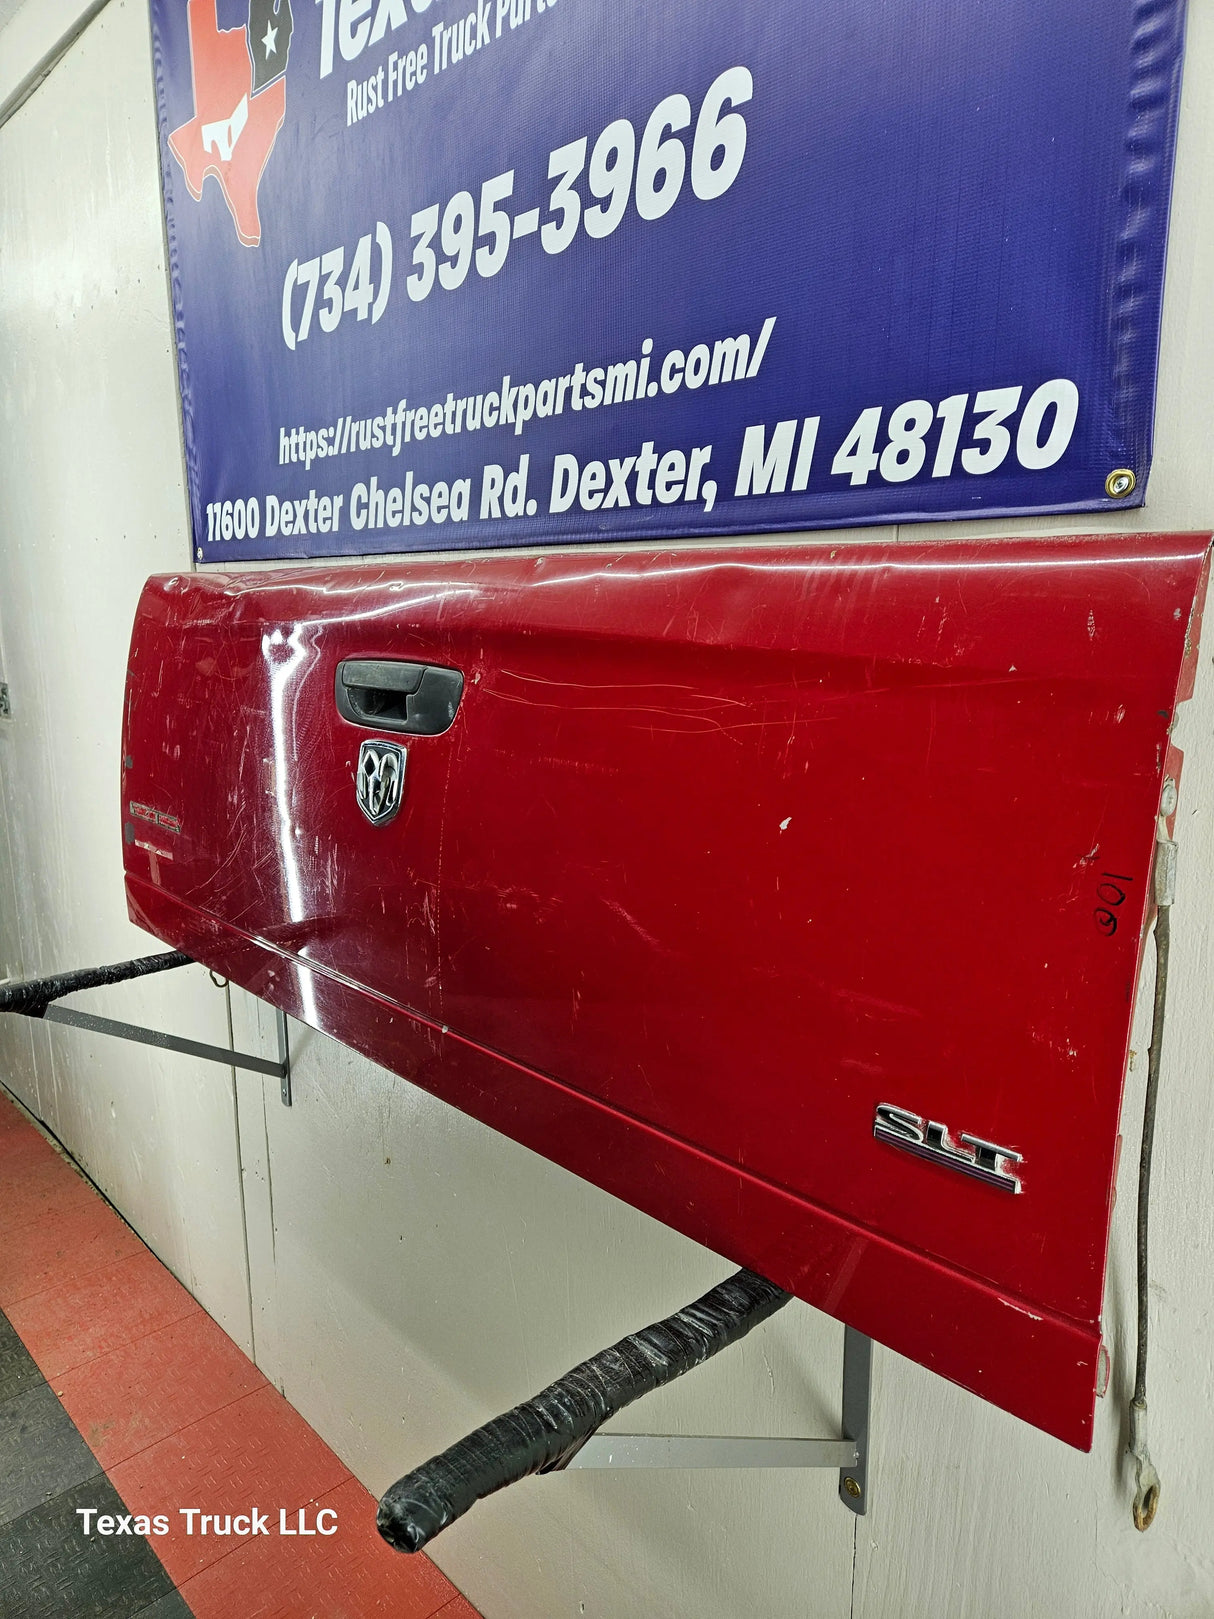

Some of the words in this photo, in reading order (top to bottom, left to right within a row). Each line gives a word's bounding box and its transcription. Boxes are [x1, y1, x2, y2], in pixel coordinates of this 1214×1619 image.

[315, 0, 439, 80] Tex
[347, 66, 385, 127] Rust
[388, 43, 428, 102] Free
[432, 0, 492, 75] Truck
[281, 222, 393, 351] (734)
[405, 66, 754, 302] 395-3966
[206, 497, 260, 542] 11600
[265, 489, 344, 537] Dexter
[349, 471, 472, 530] Chelsea
[479, 453, 538, 520] Rd.
[548, 440, 718, 512] Dexter,
[733, 415, 821, 497] MI
[830, 378, 1080, 486] 48130
[279, 316, 778, 470] https://rustfreetruckpartsmi.com/
[875, 1102, 1024, 1184] SLT
